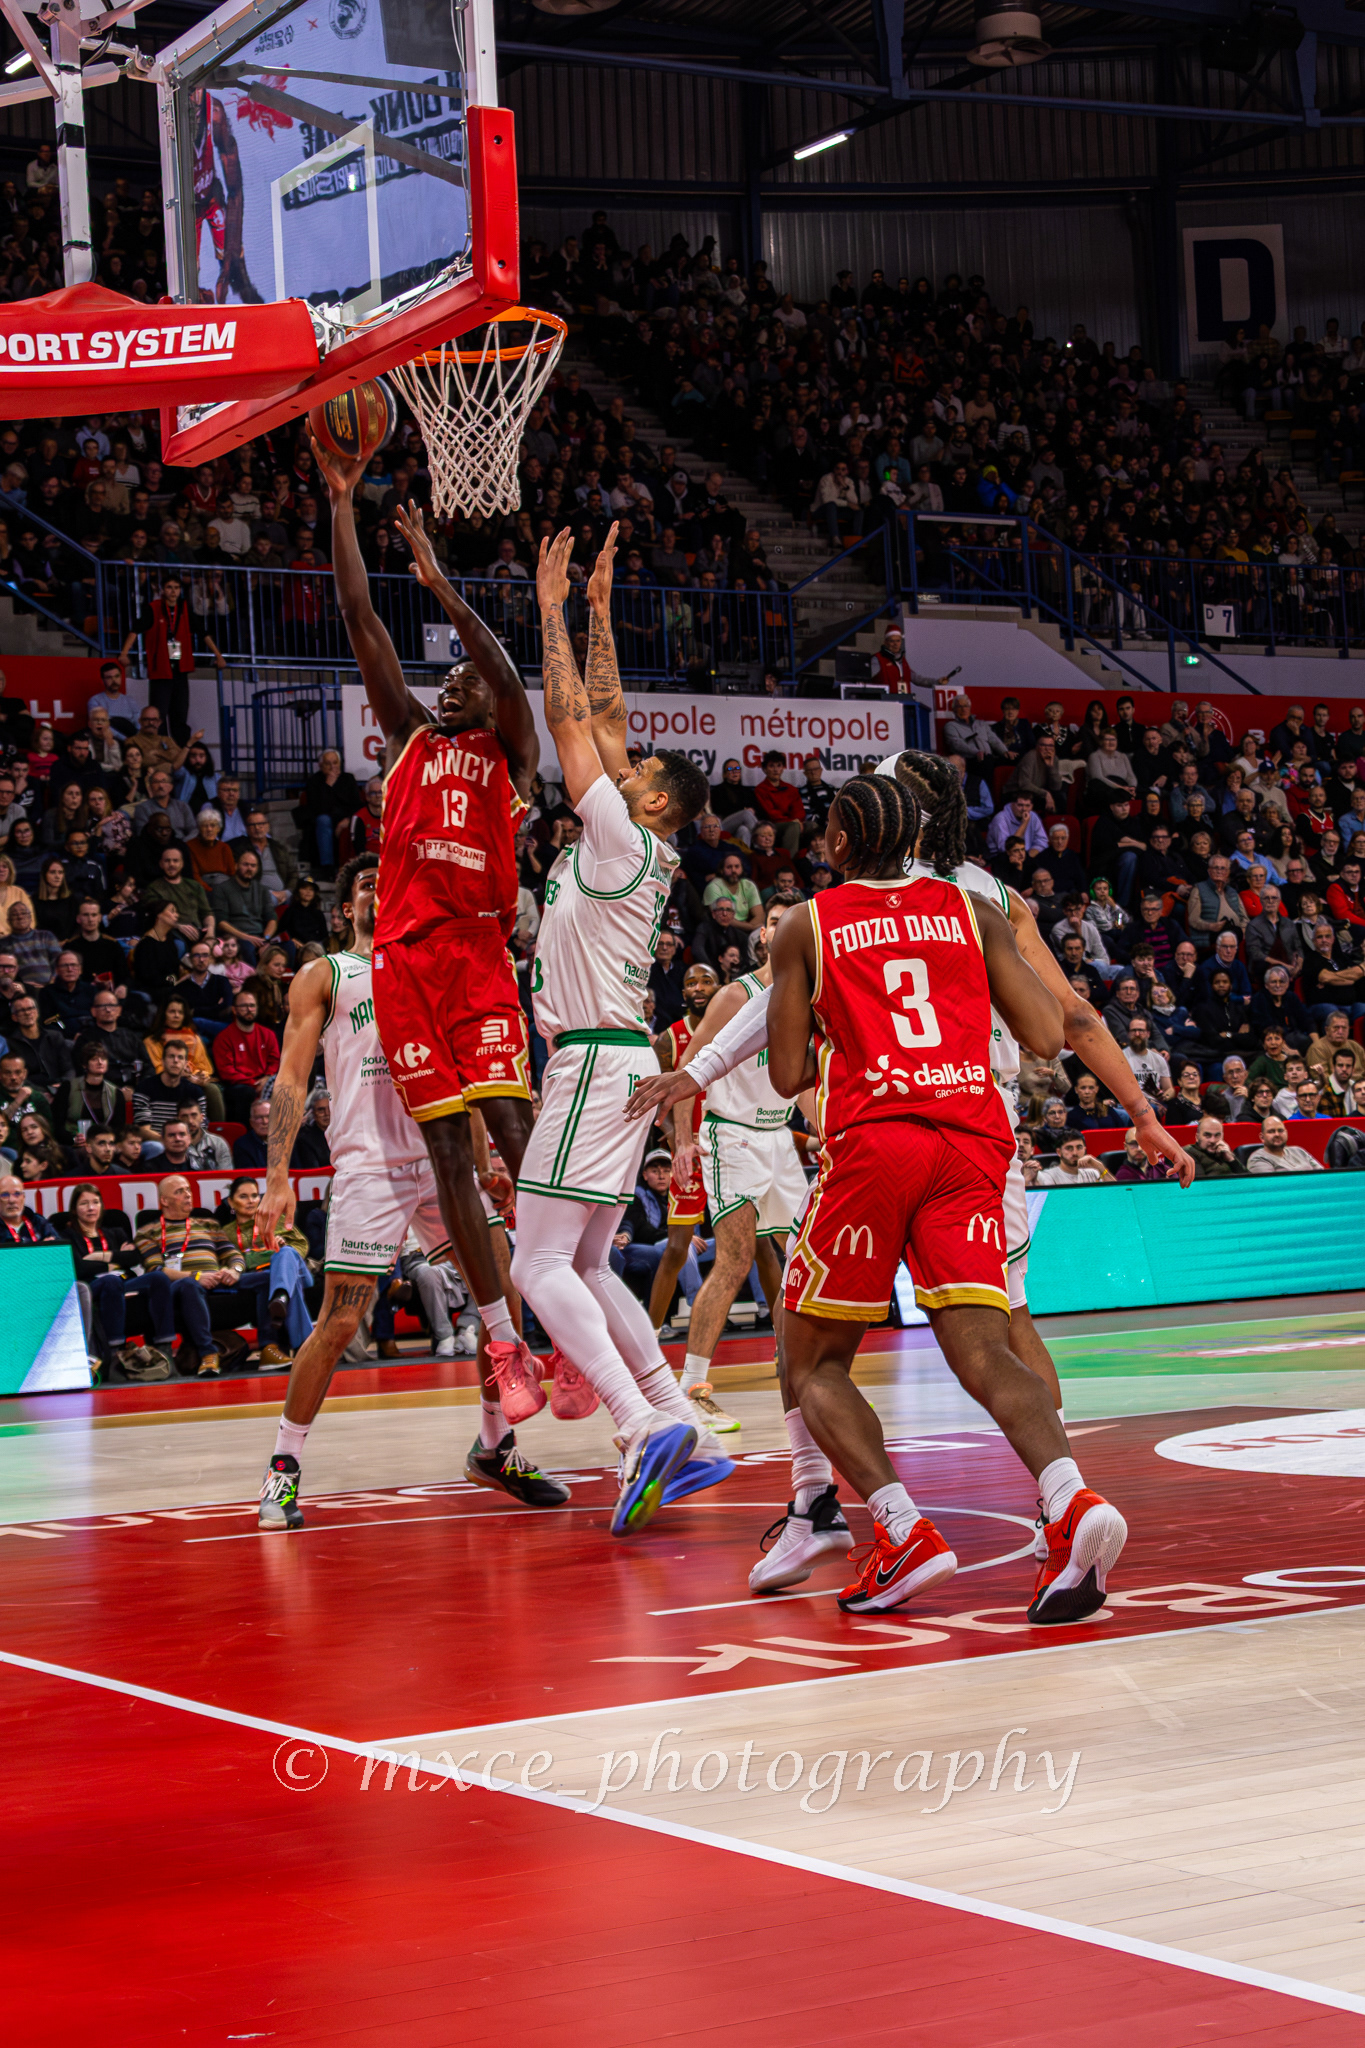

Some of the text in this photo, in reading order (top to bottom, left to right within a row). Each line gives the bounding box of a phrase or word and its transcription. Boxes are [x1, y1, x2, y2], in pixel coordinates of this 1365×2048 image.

[1192, 238, 1277, 342] D
[0, 321, 237, 368] ORT SYSTEM
[1206, 608, 1232, 633] D 7
[628, 705, 890, 746] opole métropole
[421, 748, 496, 788] NANCY
[441, 789, 468, 829] 13
[426, 841, 446, 852] BTP
[829, 915, 967, 959] FODZO DADA
[883, 958, 942, 1048] 3
[476, 1043, 517, 1057] EIFFAGE
[397, 1067, 436, 1082] Carrefour
[913, 1060, 986, 1086] dalkia
[935, 1085, 968, 1099] GROUPE
[756, 1107, 786, 1117] Bouygues
